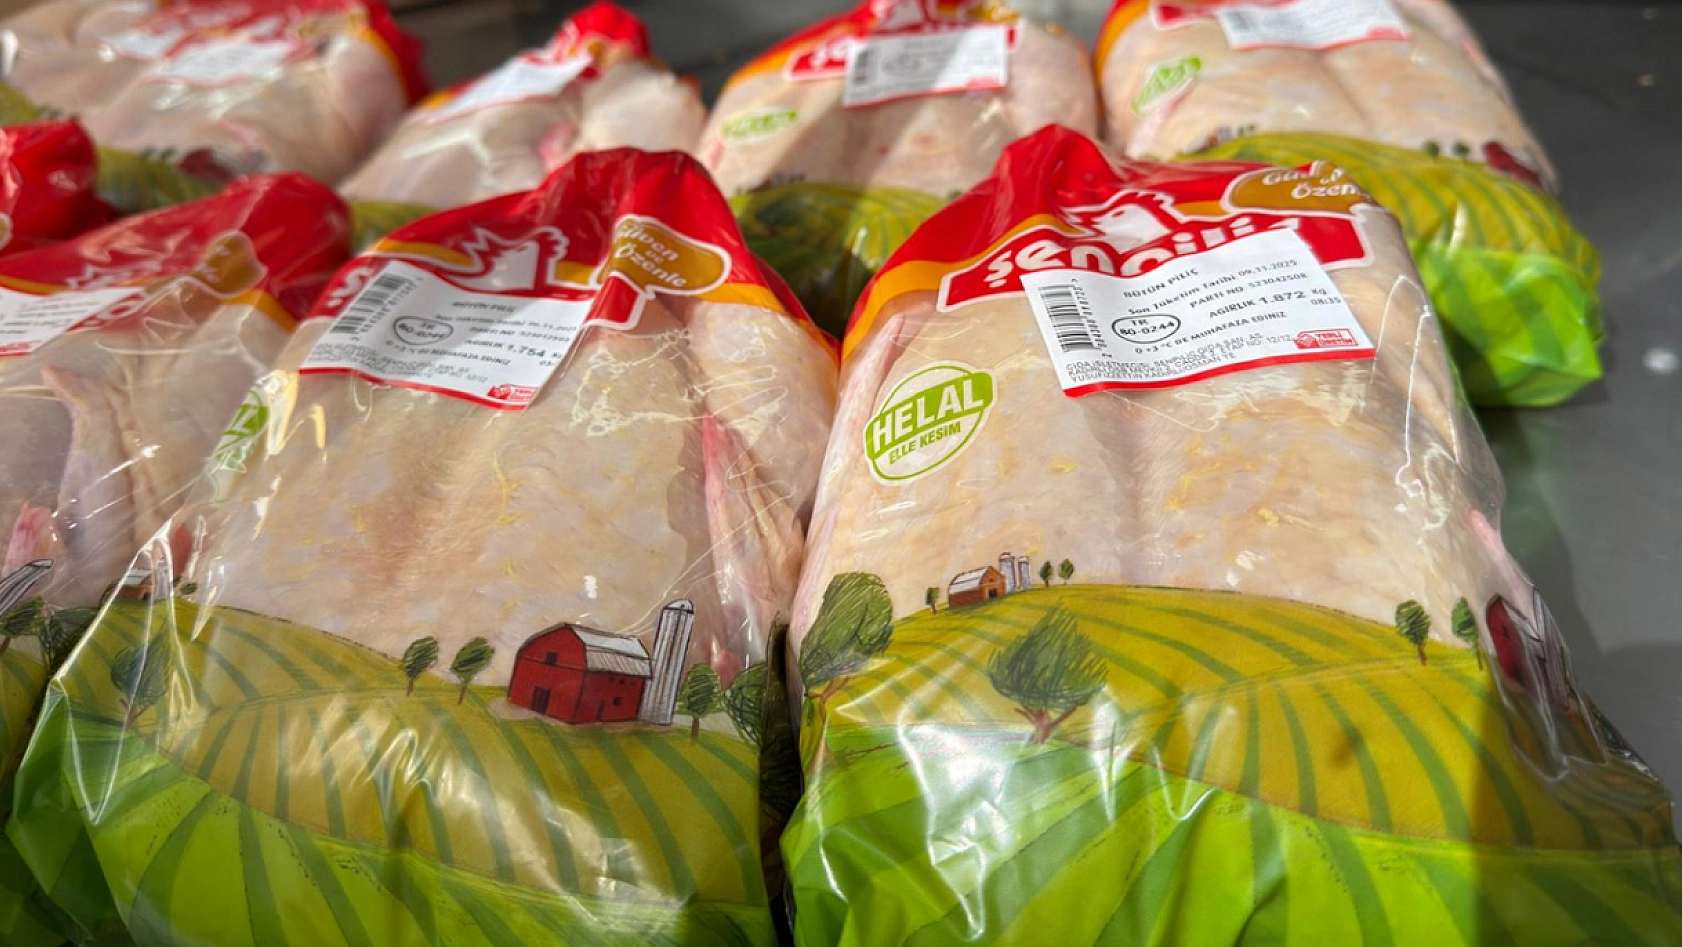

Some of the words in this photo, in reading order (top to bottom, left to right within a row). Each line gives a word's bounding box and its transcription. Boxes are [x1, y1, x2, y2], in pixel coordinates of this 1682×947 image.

[614, 242, 688, 288] Özenle
[1123, 282, 1166, 298] BÜTÜN
[1128, 306, 1150, 315] Son
[1153, 286, 1200, 310] Tüketim
[1202, 274, 1236, 291] Tarihi
[1238, 259, 1298, 277] 09.11.2025
[1225, 286, 1244, 297] NO
[1257, 290, 1306, 305] 1.872
[1119, 320, 1176, 336] 80-0244
[1130, 318, 1150, 326] TR
[1190, 317, 1250, 340] MUHAFAZA
[872, 378, 984, 455] HELAL
[888, 439, 917, 466] ELLE
